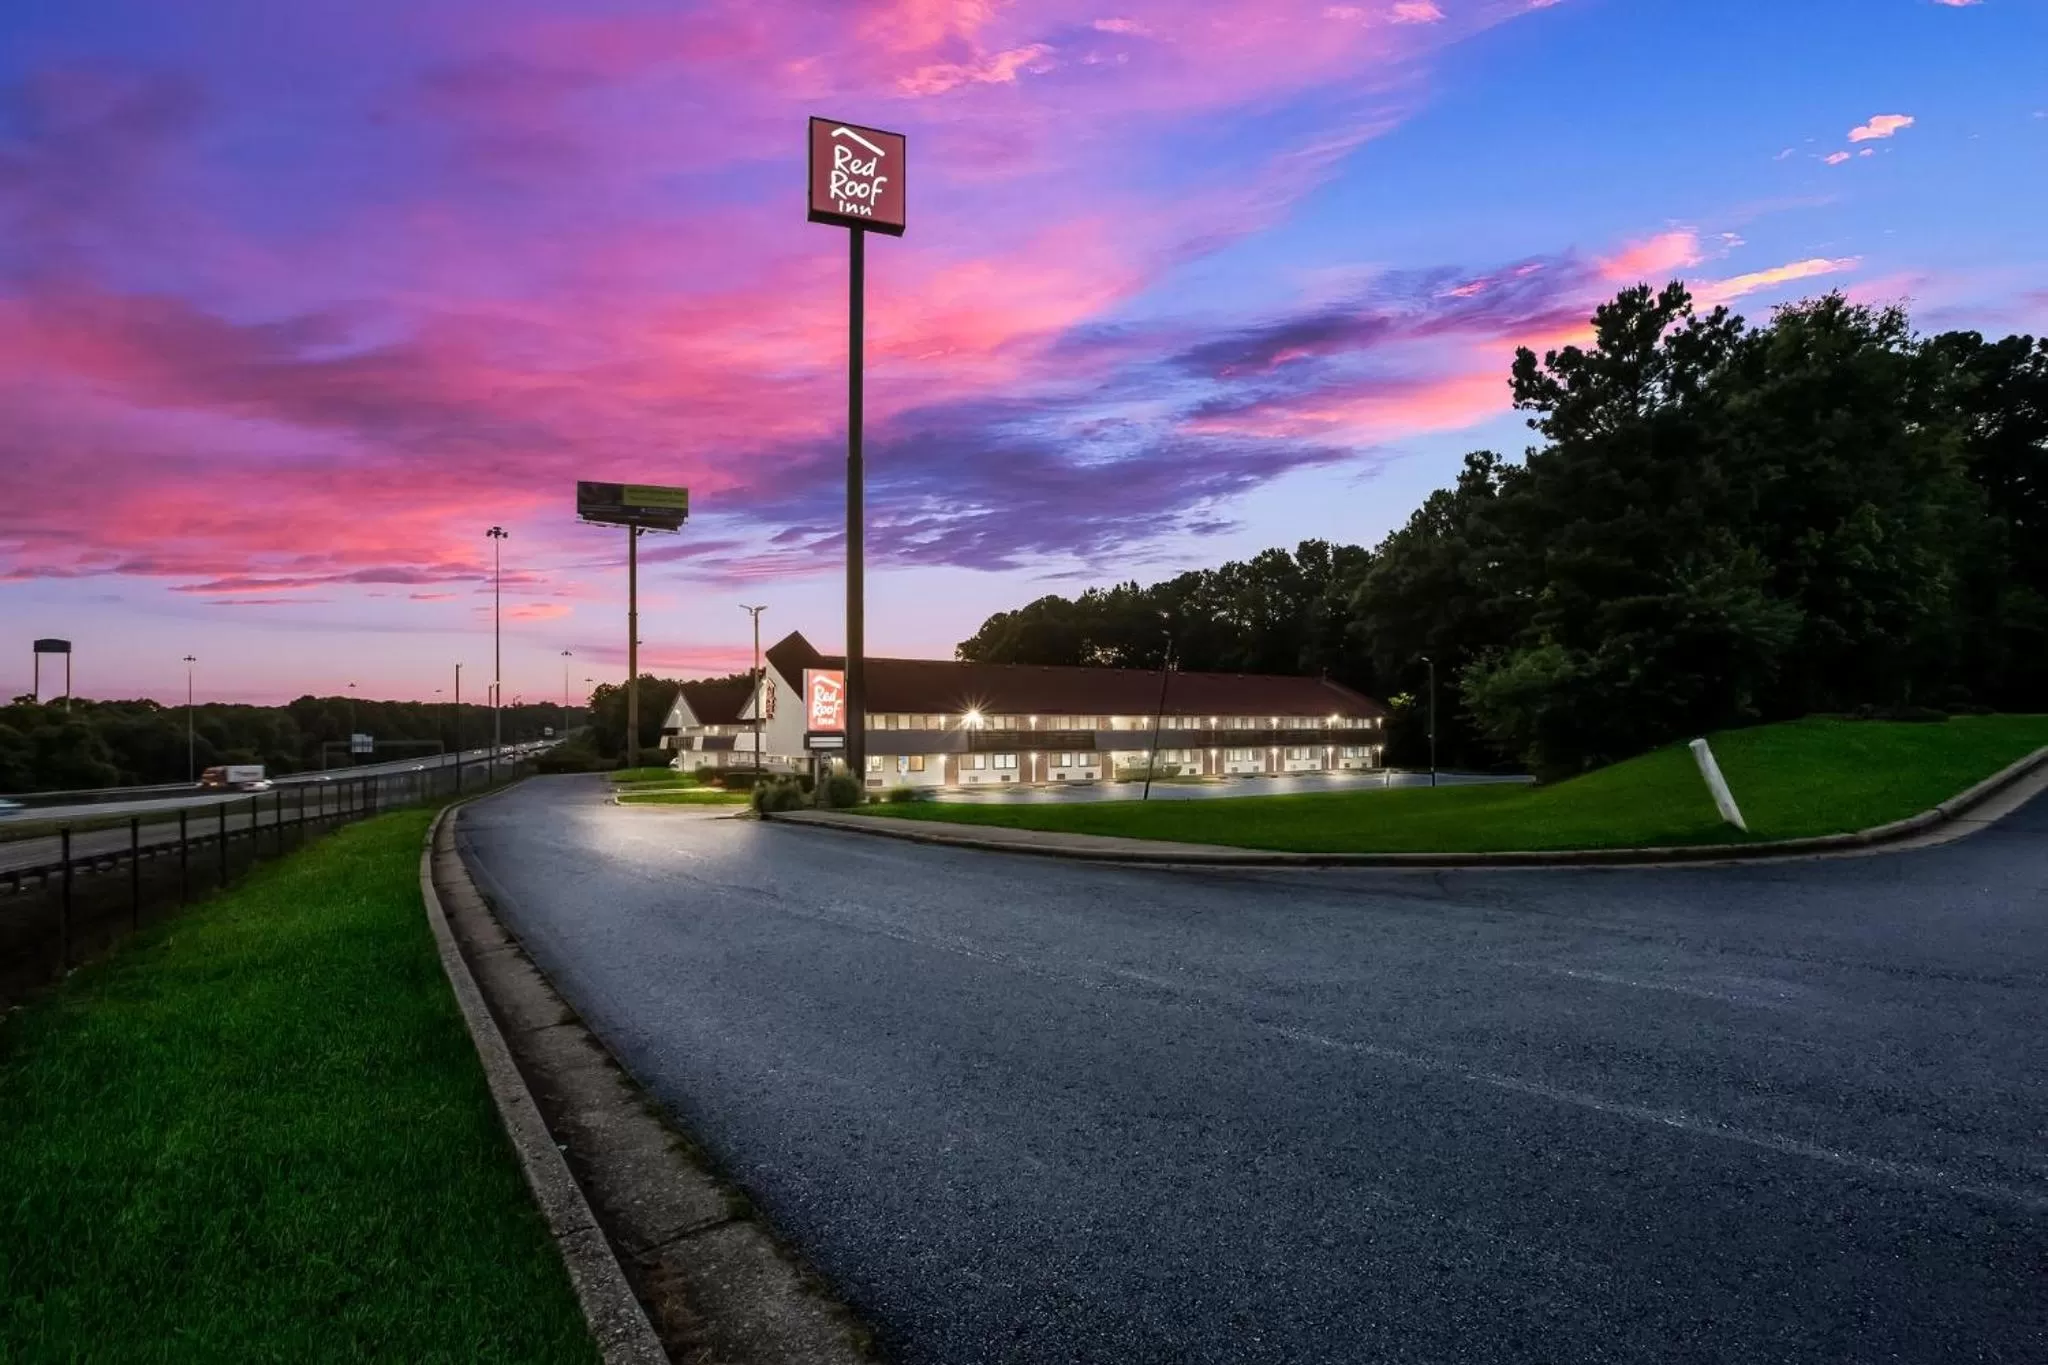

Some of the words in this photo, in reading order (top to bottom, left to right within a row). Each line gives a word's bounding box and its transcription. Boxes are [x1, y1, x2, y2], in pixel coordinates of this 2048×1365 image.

[834, 144, 877, 177] Red
[829, 170, 888, 206] Roof
[813, 684, 837, 701] Red
[812, 700, 843, 718] Roof
